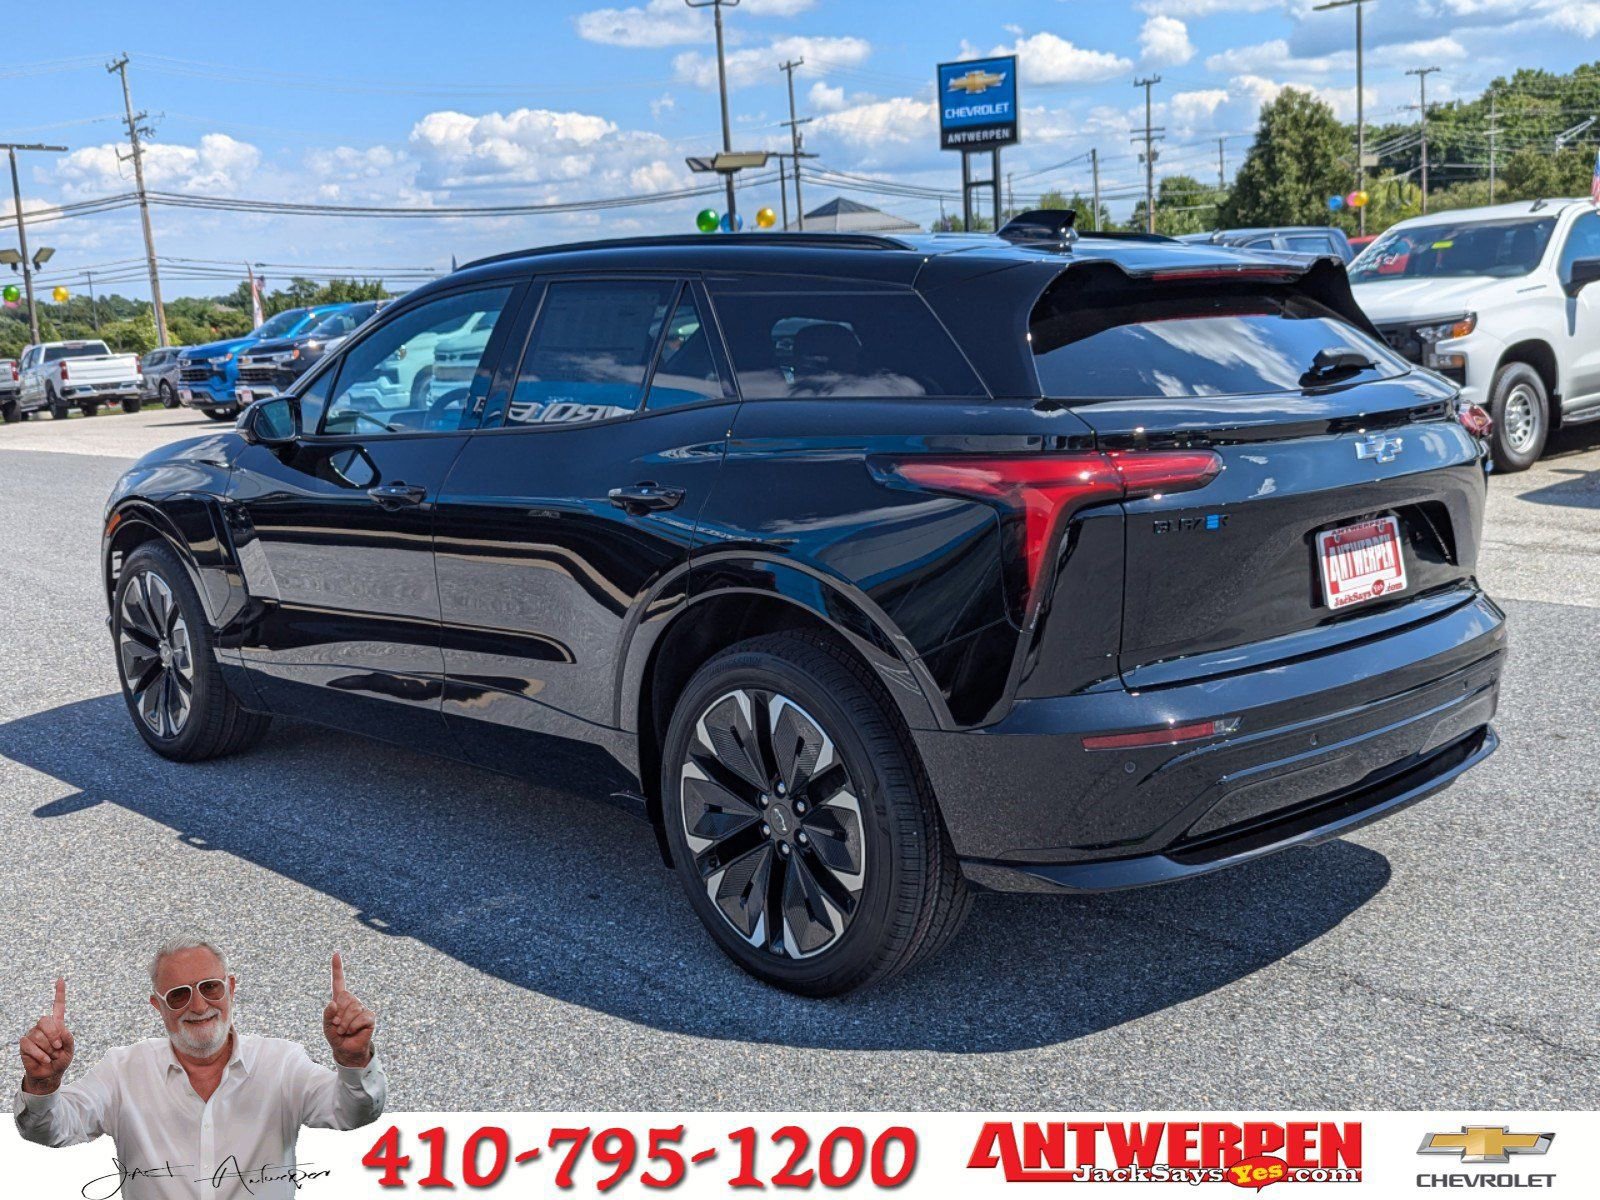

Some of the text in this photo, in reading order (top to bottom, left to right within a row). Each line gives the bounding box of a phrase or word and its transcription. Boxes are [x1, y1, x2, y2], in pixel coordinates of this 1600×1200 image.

[945, 102, 1009, 119] CHEVROLET
[947, 128, 1010, 144] ANTWERPEN
[1328, 533, 1396, 583] ANTWERPEN
